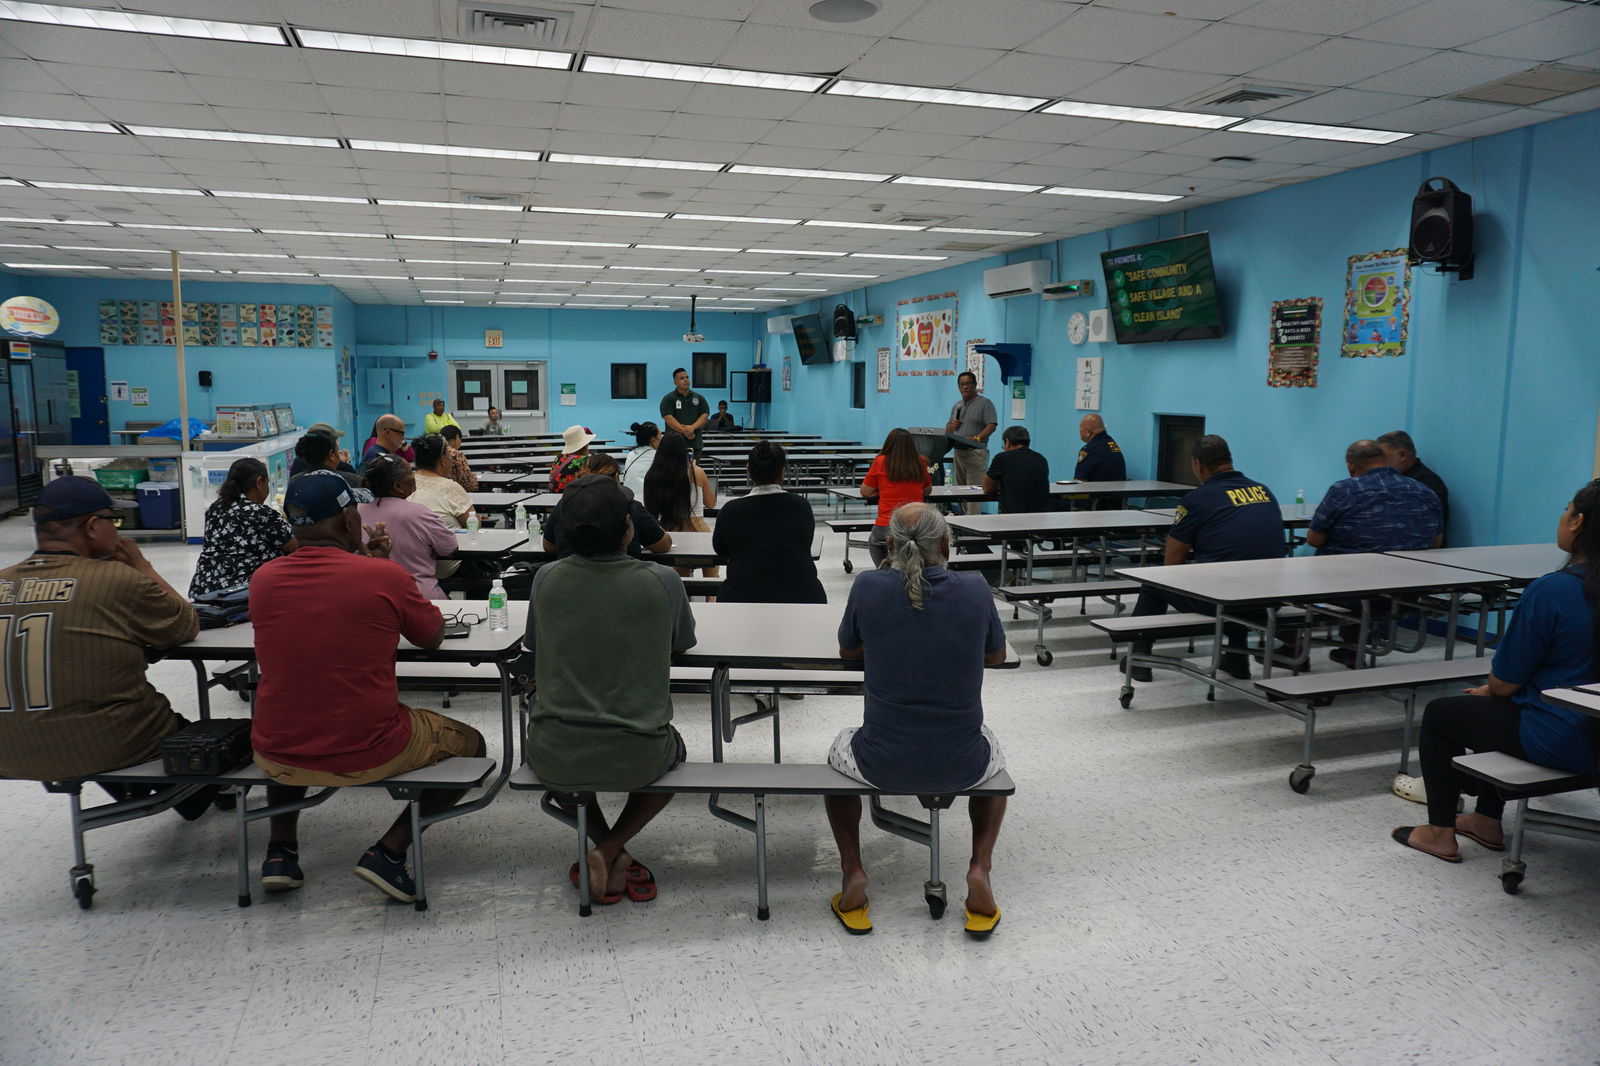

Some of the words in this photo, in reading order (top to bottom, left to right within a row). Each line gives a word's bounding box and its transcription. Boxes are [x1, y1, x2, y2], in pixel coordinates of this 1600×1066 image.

[1115, 255, 1136, 265] PROMOTE
[1148, 263, 1188, 279] COMMUNITY
[1129, 291, 1147, 303] SAFE
[1148, 287, 1177, 301] VILLAGE
[1178, 284, 1194, 297] AND
[1196, 284, 1203, 295] A
[1133, 311, 1155, 323] CLEAN
[1276, 320, 1282, 328] 6
[488, 336, 501, 346] EXIT
[1226, 485, 1271, 507] POLICE
